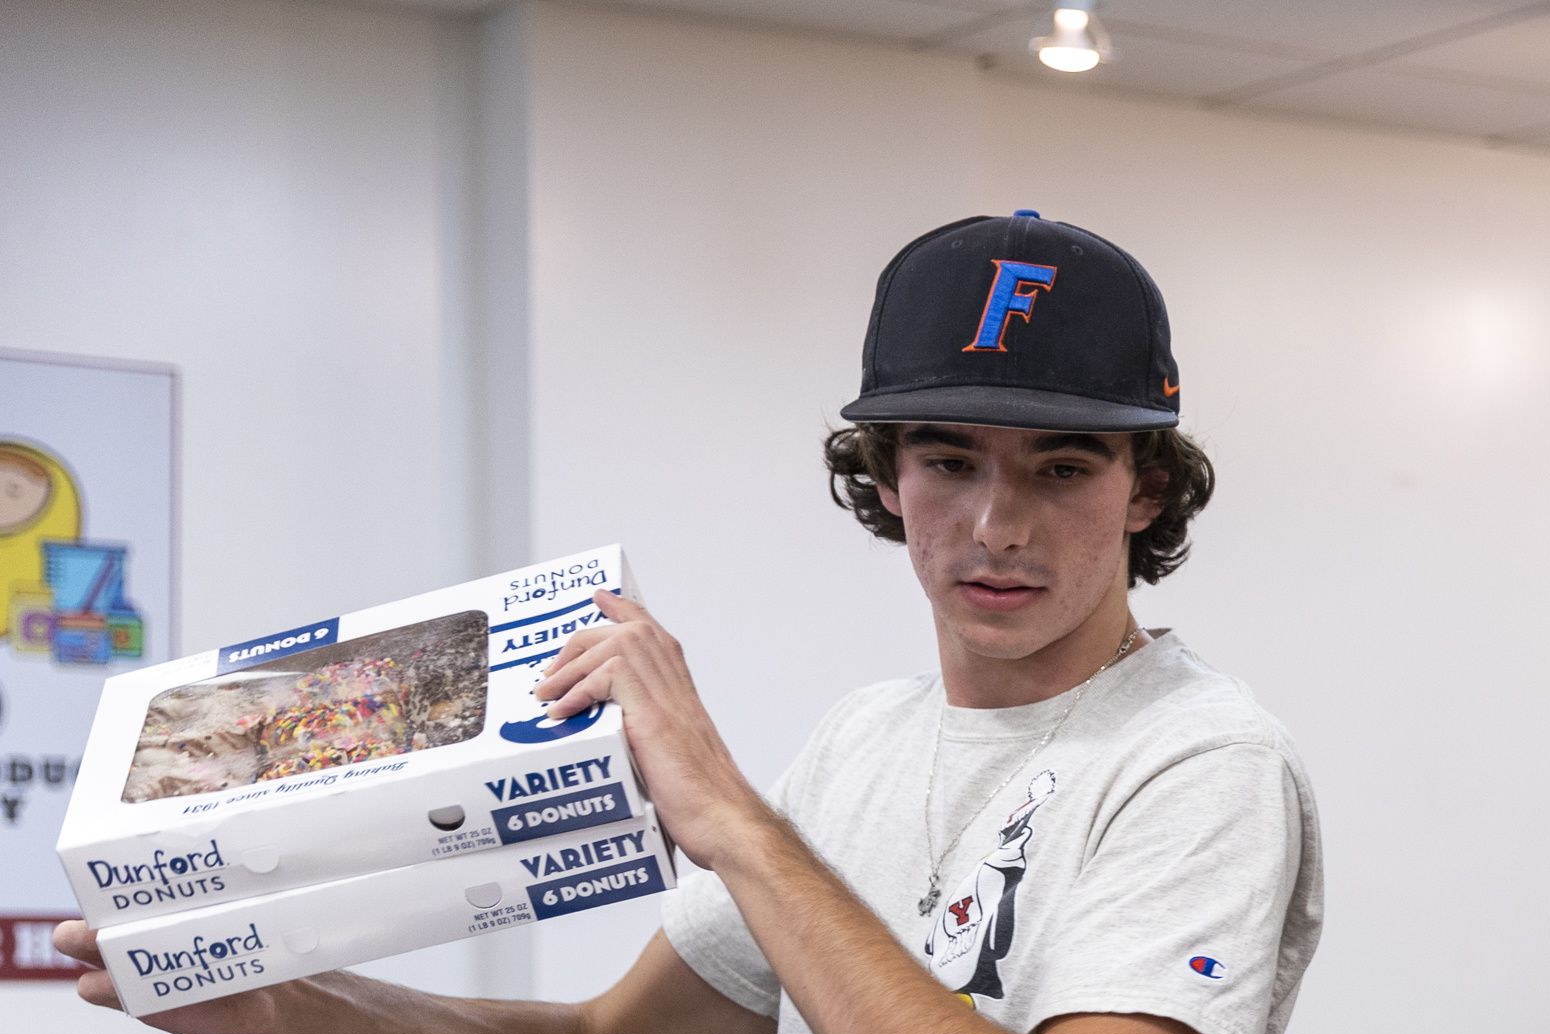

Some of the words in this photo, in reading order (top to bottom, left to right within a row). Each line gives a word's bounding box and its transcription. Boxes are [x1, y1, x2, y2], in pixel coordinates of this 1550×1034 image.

[961, 259, 1058, 353] F
[503, 570, 608, 611] Dunford
[510, 559, 599, 590] DONUTS
[229, 631, 312, 663] DONUTS
[313, 628, 329, 639] 6
[485, 755, 611, 803] VARIETY
[506, 814, 523, 831] 6
[526, 794, 616, 828] DONUTS
[87, 839, 224, 888] Dunford
[520, 829, 646, 879] VARIETY
[112, 876, 226, 910] DONUTS
[542, 890, 558, 906] 6
[560, 867, 649, 902] DONUTS
[474, 913, 489, 922] NET
[490, 909, 504, 917] WT
[505, 906, 515, 914] 25
[478, 921, 489, 930] LB
[948, 895, 974, 926] Y
[127, 923, 264, 976] Dunford
[153, 959, 265, 997] DONUTS
